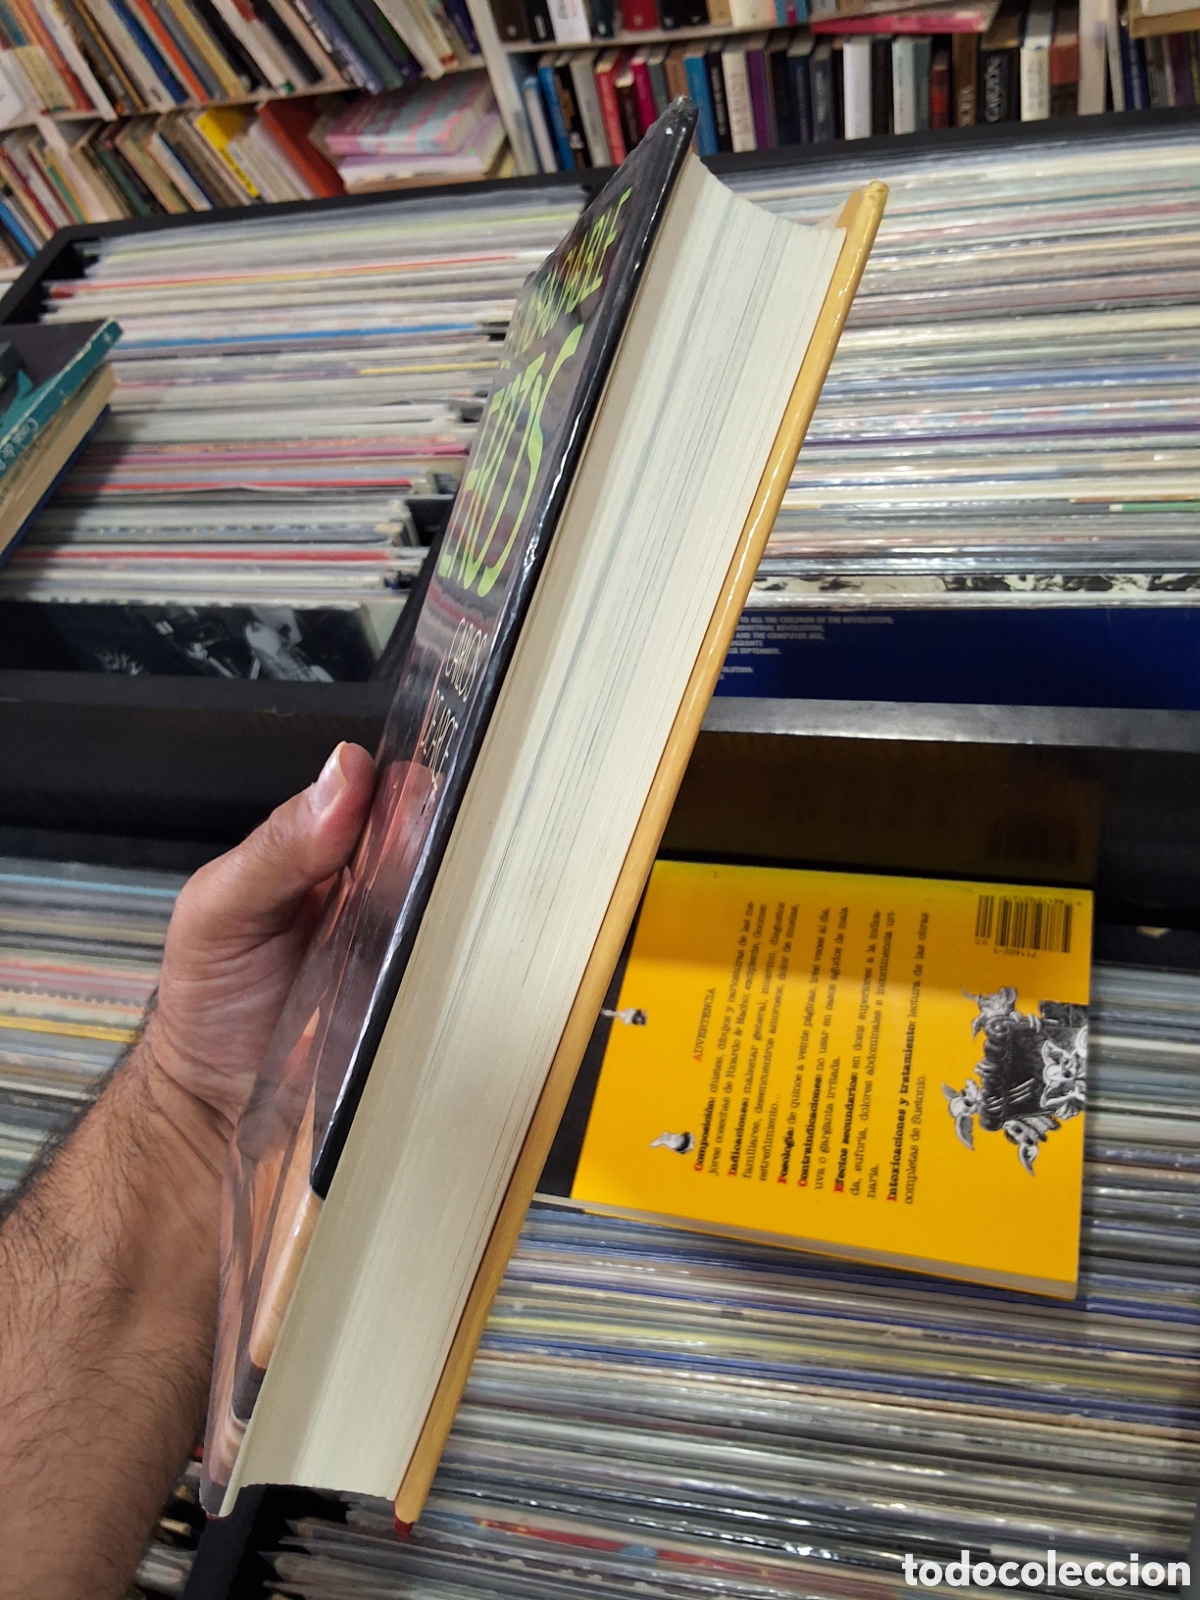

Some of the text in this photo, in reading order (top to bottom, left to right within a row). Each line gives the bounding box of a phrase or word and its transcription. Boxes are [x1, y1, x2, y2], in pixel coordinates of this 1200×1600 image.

[438, 324, 584, 597] EROS
[445, 616, 489, 703] CARLOS
[738, 935, 747, 946] de
[740, 920, 751, 932] las
[818, 925, 827, 934] al
[782, 941, 792, 953] de
[814, 936, 825, 961] veces
[866, 943, 876, 952] la
[876, 930, 893, 995] incontinencia
[777, 955, 789, 980] dolor
[810, 964, 821, 983] tres
[725, 1005, 734, 1013] y
[768, 984, 785, 1034] amorosos,
[803, 987, 817, 1027] páginas,
[858, 967, 873, 1020] superiores
[692, 987, 717, 1063] ADVERTENCIA
[716, 1015, 731, 1050] dibujos
[727, 902, 786, 1177] Indicaciones: malestar general, muermo, disgustos
[798, 1029, 810, 1060] veinte
[853, 1024, 865, 1051] dosis
[865, 1010, 882, 1076] abdominales
[725, 1039, 741, 1078] Ricardo
[797, 906, 849, 1188] Contraindicaciones: no usar en casos agudos de mala
[851, 1056, 861, 1069] en
[886, 912, 930, 1202] Intoxicaciones y tratamiento: lectura de las obras
[709, 1054, 725, 1093] chistes,
[723, 1081, 733, 1094] de
[754, 1037, 775, 1114] desencuentros
[790, 1074, 803, 1108] quince
[715, 1096, 730, 1144] cosechas
[786, 1112, 797, 1125] de
[842, 1072, 858, 1145] secundarios:
[859, 1080, 873, 1121] dolores
[694, 1097, 716, 1172] Composición:
[814, 1056, 841, 1189] uva o garganta irritada.
[904, 1074, 926, 1204] completas de Suetonio.
[708, 1147, 721, 1176] jores
[741, 1118, 762, 1179] familiares,
[853, 1127, 869, 1172] euforia,
[833, 1148, 848, 1193] Efectos
[849, 1178, 863, 1196] da,
[867, 1164, 879, 1199] naria.
